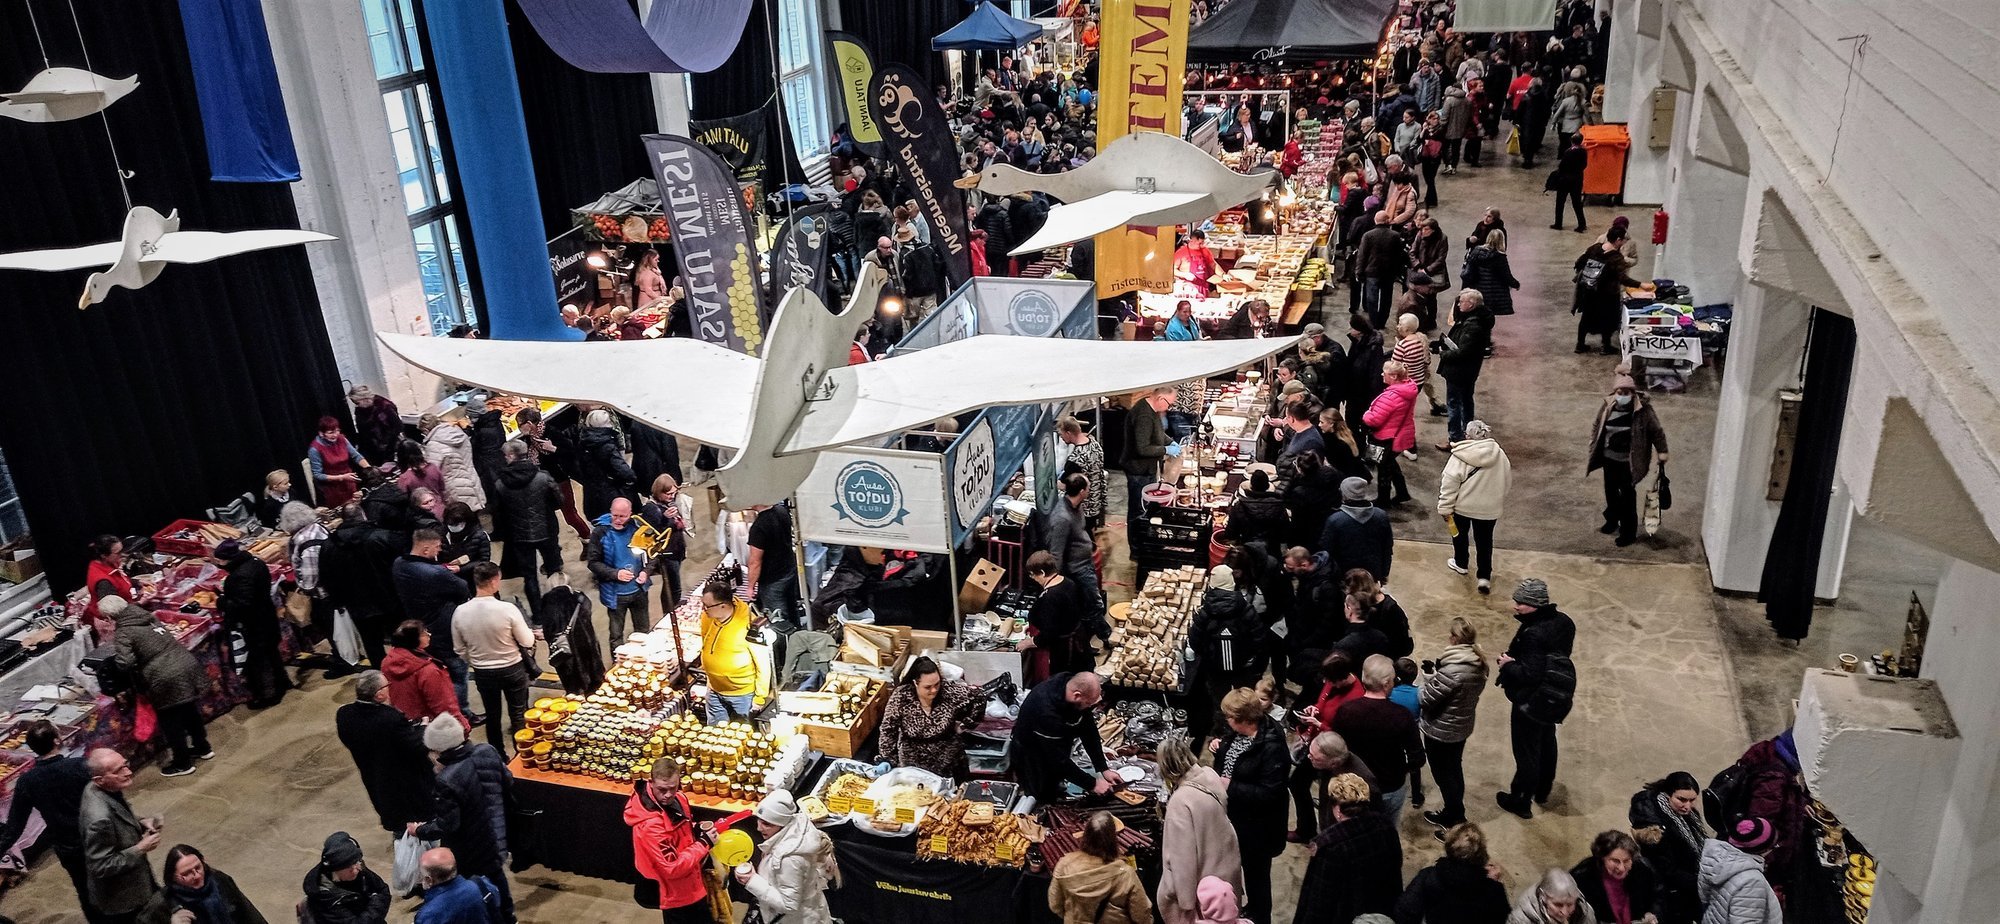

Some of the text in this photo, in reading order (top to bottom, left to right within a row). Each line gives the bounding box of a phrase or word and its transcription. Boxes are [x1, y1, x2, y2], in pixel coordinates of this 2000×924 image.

[723, 128, 749, 154] TALU
[1111, 276, 1170, 291] ristemäe.eu
[1635, 337, 1689, 351] FRIDA
[859, 505, 883, 513] KLUBI
